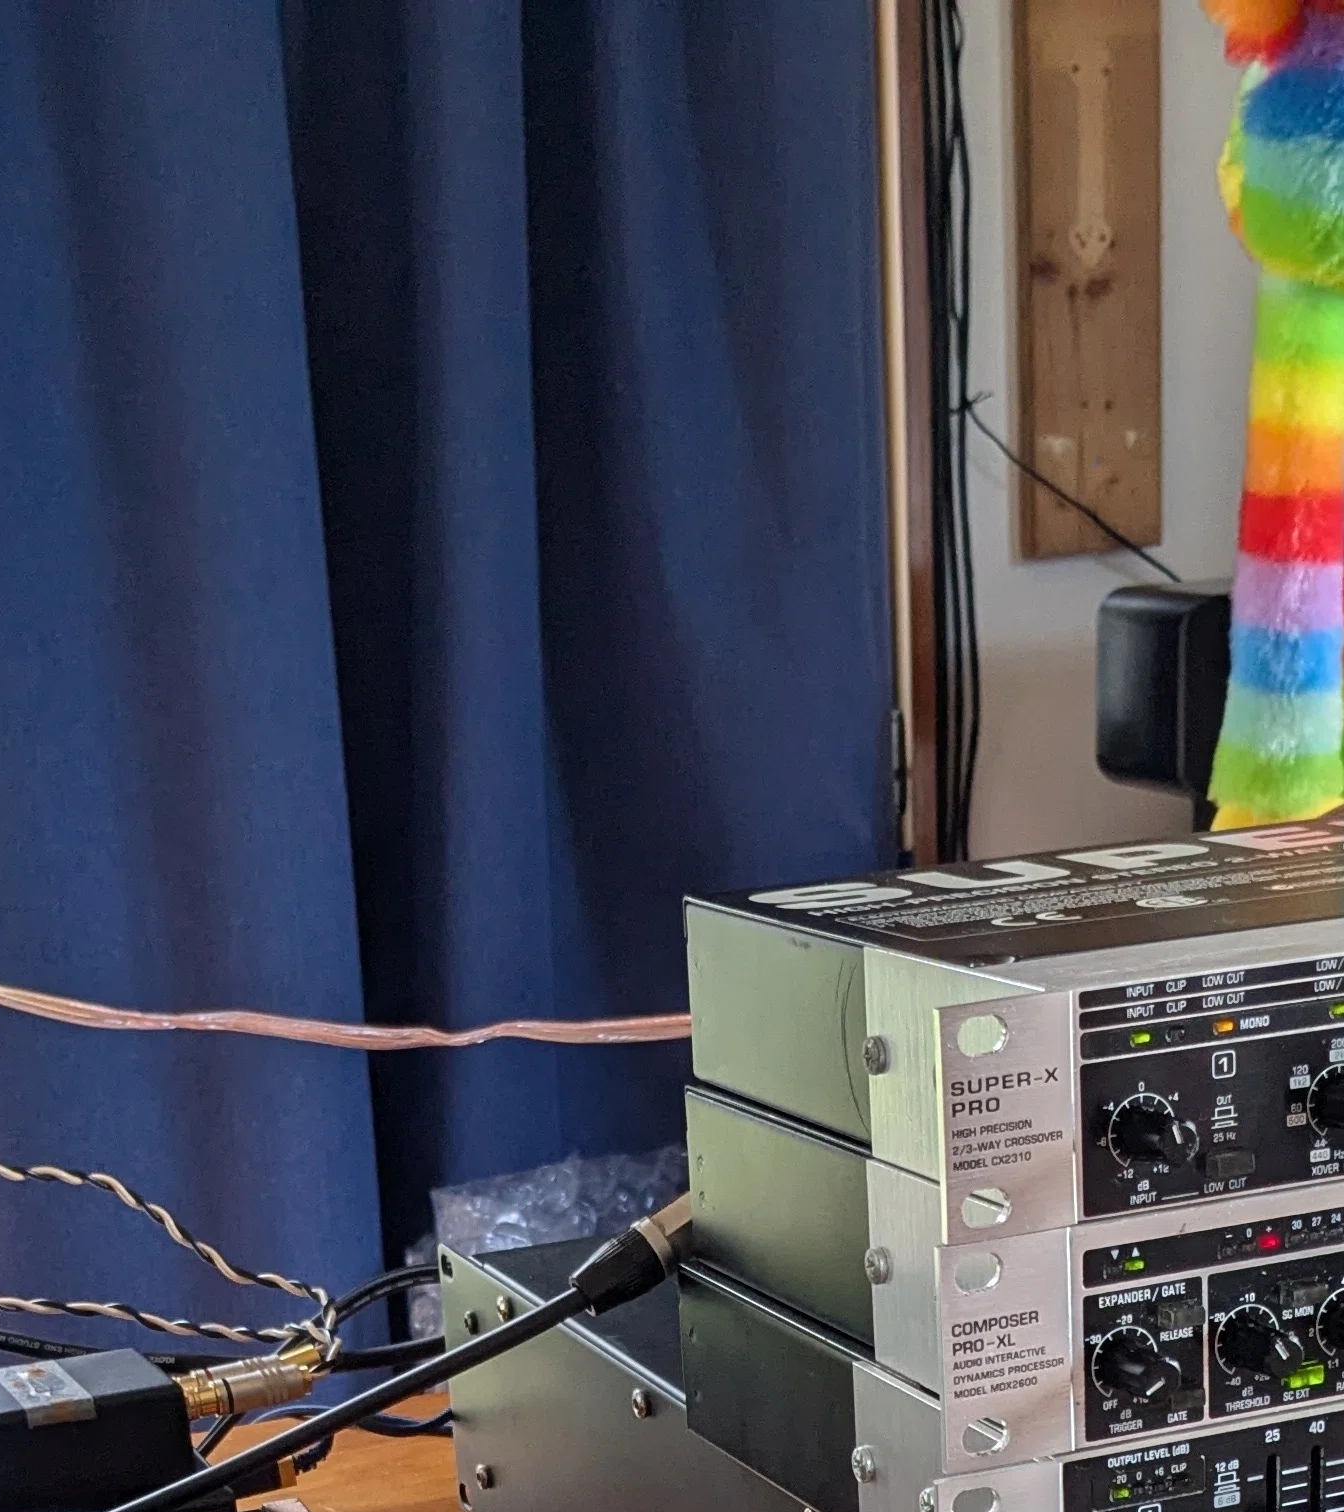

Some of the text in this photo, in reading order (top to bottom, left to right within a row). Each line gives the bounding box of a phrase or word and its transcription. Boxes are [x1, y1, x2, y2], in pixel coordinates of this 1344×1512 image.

[1126, 972, 1245, 998] INPUT CLIP LOW CUT
[1126, 992, 1245, 1018] INPUT CLIP LOW CUT
[1240, 1015, 1270, 1030] MONO
[950, 1067, 1059, 1097] SUPER-X
[952, 1097, 1001, 1119] PRO
[952, 1119, 1032, 1140] HIGH PRECISION
[952, 1131, 1063, 1157] 2/3-WAY CROSSOVER
[952, 1151, 1032, 1172] MODEL CX2310
[1204, 1177, 1247, 1194] LOW CUT
[1130, 1192, 1157, 1205] INPUT
[1098, 1283, 1186, 1309] EXPANDER GATE
[951, 1310, 1039, 1338] COMPOSER
[1159, 1327, 1194, 1342] RELEASE
[952, 1335, 1016, 1357] PRO-XL
[952, 1346, 1046, 1371] AUDIO INTERACTIVE
[953, 1357, 1065, 1385] DYNAMICS PROCESSOR
[953, 1376, 1038, 1400] MODEL MDX2600
[1225, 1395, 1270, 1412] THRESHOLD
[1109, 1420, 1143, 1434] TRIGGER
[1167, 1411, 1188, 1424] GATE
[1265, 1429, 1280, 1443] 25
[1309, 1421, 1325, 1434] 40
[1108, 1443, 1190, 1468] OUTPUT LEVEL (dB)
